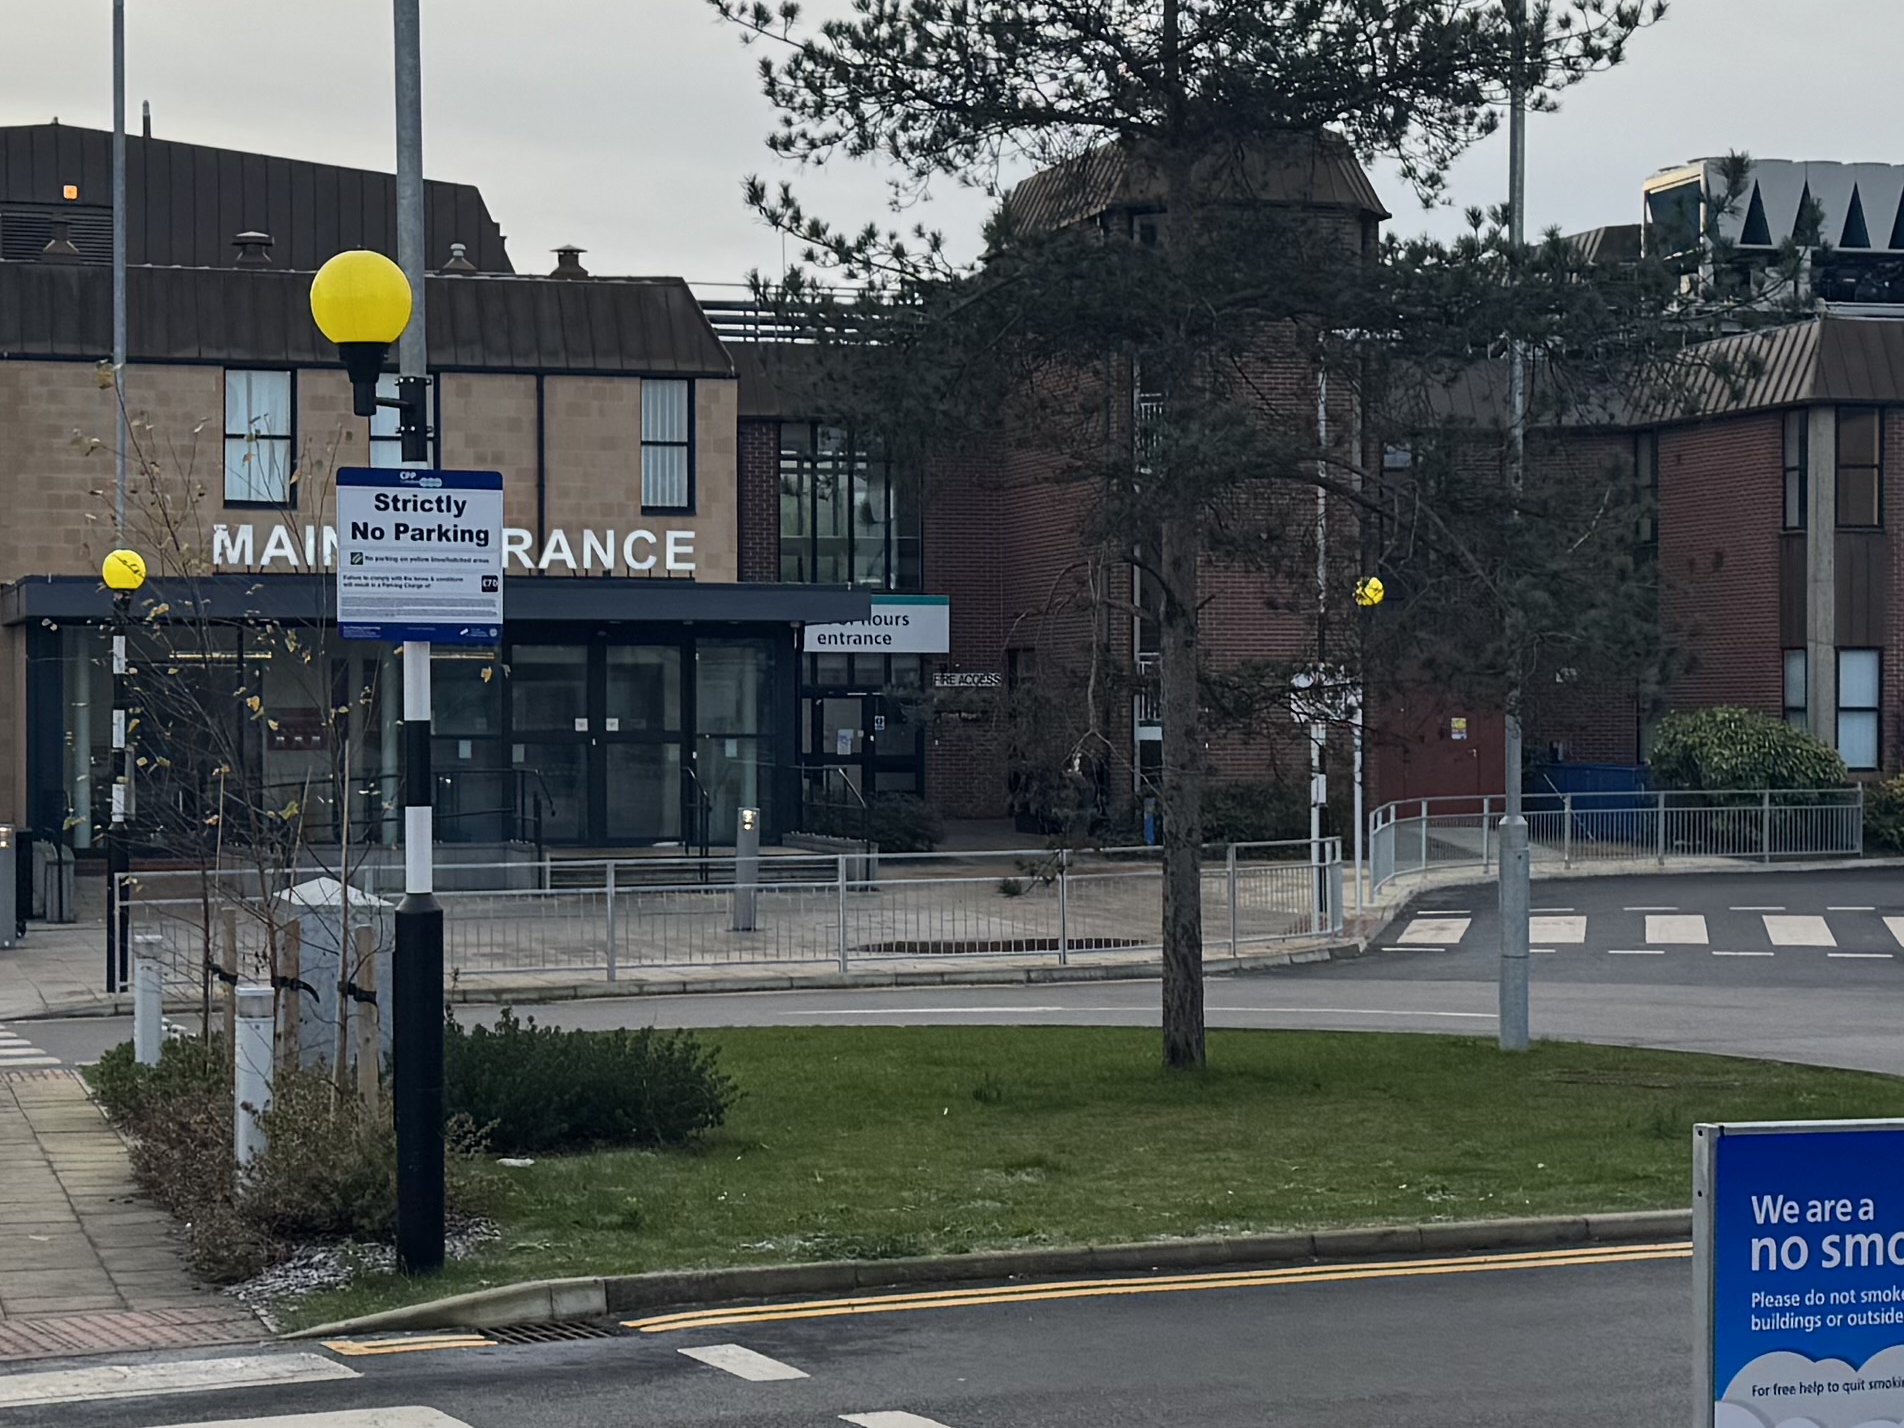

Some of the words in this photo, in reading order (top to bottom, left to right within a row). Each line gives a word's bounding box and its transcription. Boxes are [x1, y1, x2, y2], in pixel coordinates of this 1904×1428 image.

[374, 493, 467, 518] Strictly
[351, 522, 385, 540] No
[394, 523, 489, 547] Parking
[502, 528, 696, 570] RANCE
[818, 632, 892, 645] entrance
[1751, 1194, 1800, 1225] We
[1806, 1198, 1852, 1222] are
[1858, 1197, 1874, 1221] a
[1751, 1233, 1809, 1271] no
[1751, 1290, 1800, 1309] Please
[1805, 1289, 1825, 1307] do
[1829, 1288, 1856, 1305] not
[1751, 1312, 1822, 1333] buildings
[1826, 1314, 1843, 1328] or
[1847, 1306, 1904, 1326] outside
[1752, 1385, 1770, 1397] For
[1773, 1383, 1796, 1396] free
[1799, 1382, 1824, 1398] help
[1827, 1382, 1839, 1393] to
[1842, 1378, 1865, 1394] quit
